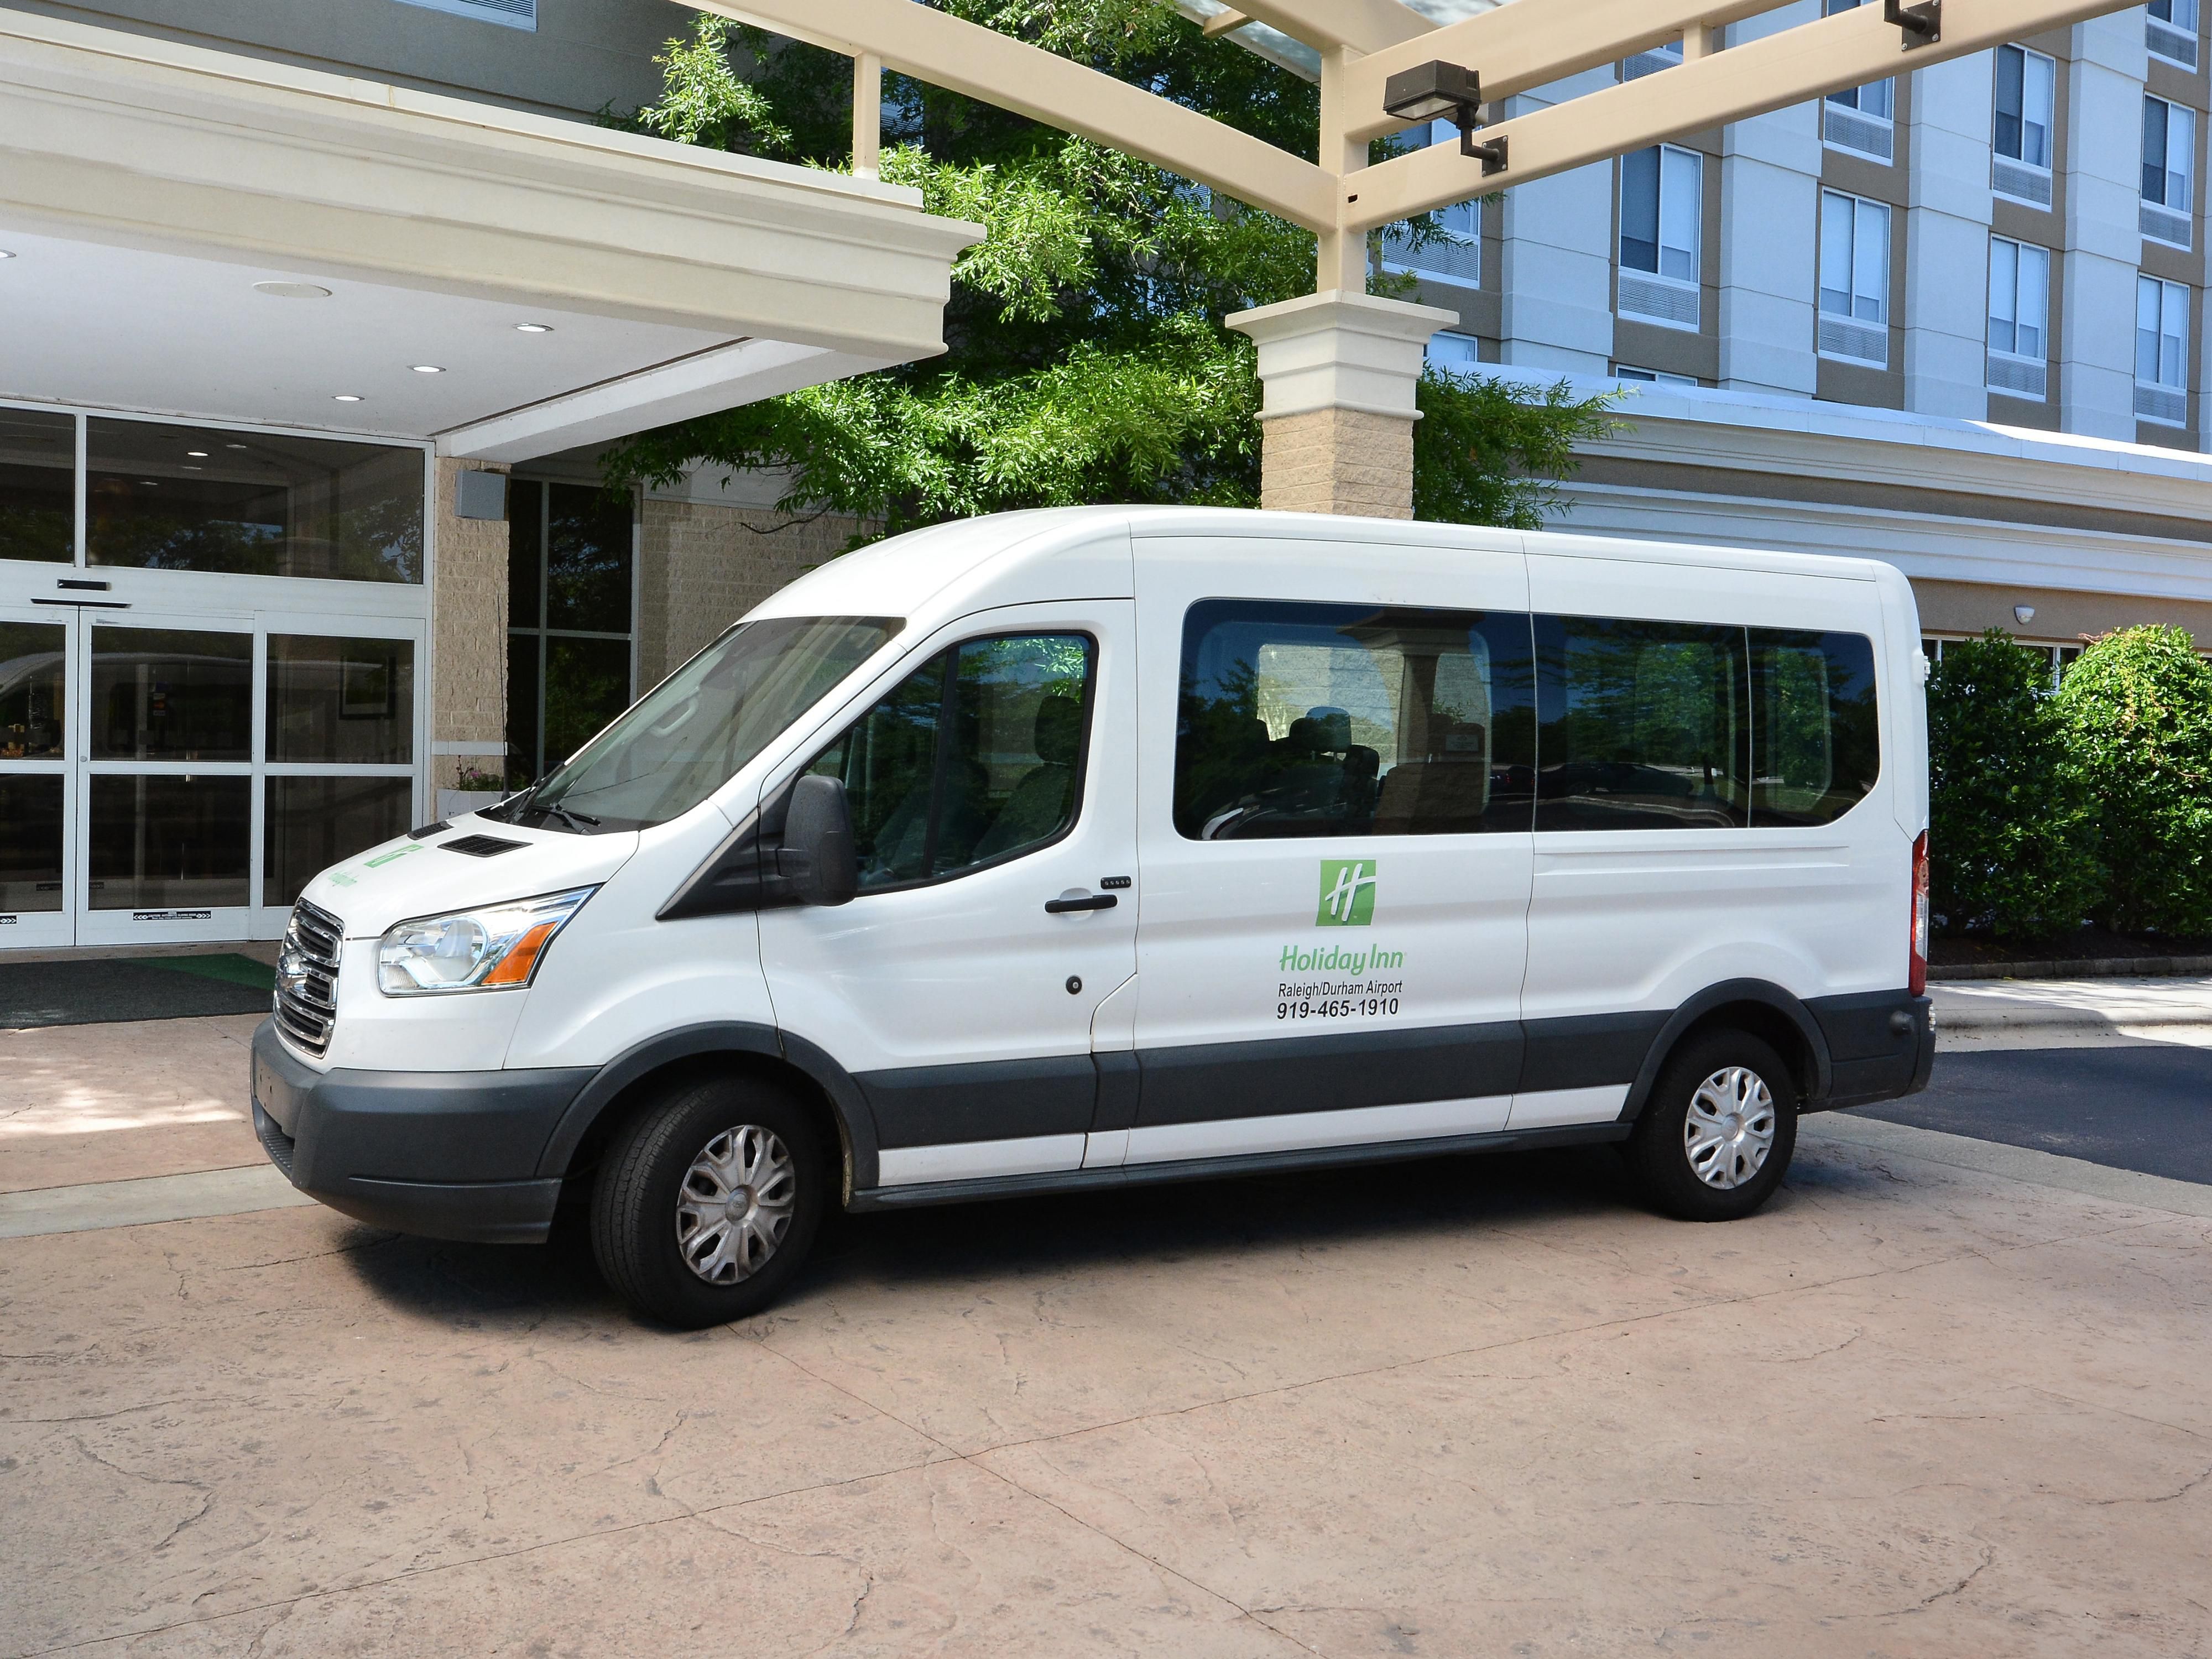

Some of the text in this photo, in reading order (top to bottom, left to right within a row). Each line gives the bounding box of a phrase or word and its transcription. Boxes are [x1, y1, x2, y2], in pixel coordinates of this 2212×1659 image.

[1279, 943, 1404, 976] Holiday Inn
[1278, 980, 1402, 1000] Raleigh/Durham Airport
[1276, 998, 1399, 1019] 919-465-1910
